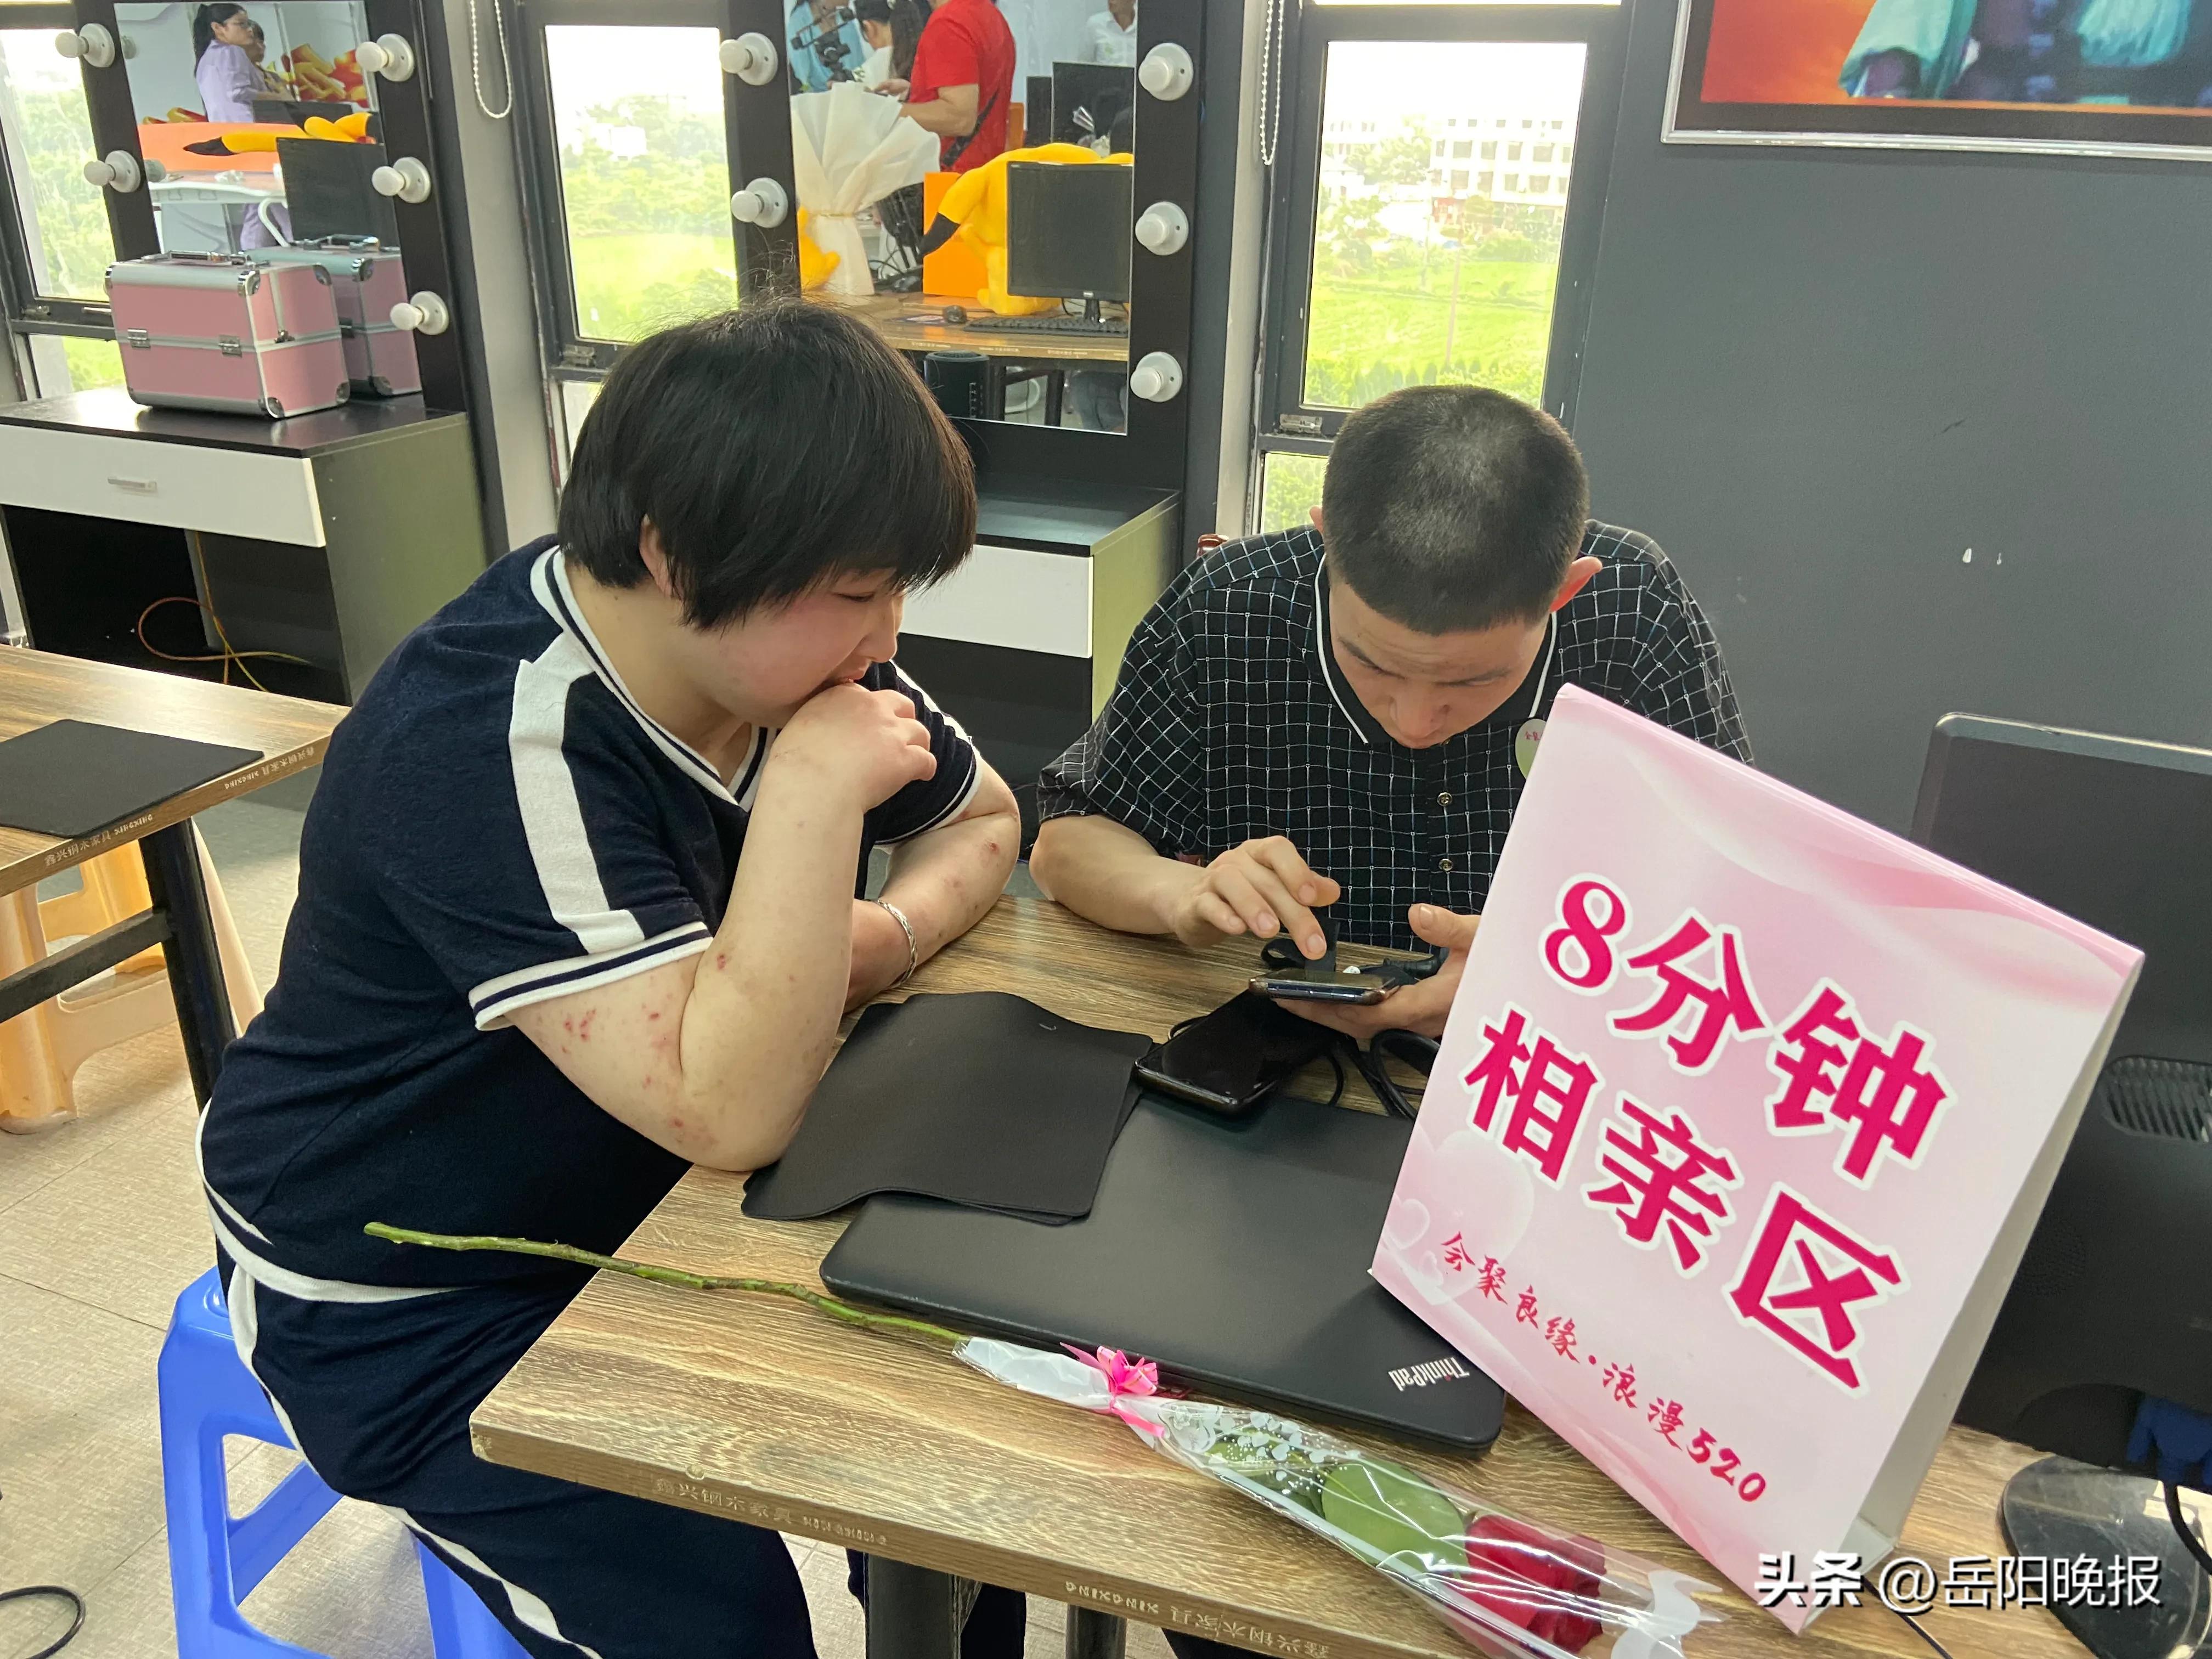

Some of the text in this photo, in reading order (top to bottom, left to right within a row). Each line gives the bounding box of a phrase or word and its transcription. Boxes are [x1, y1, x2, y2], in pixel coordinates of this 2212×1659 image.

[1543, 880, 1948, 1181] 8分钟
[1464, 1008, 1901, 1390] 相亲区
[1388, 1356, 1470, 1392] ThinkPad
[1065, 1580, 1160, 1615] XINGXING
